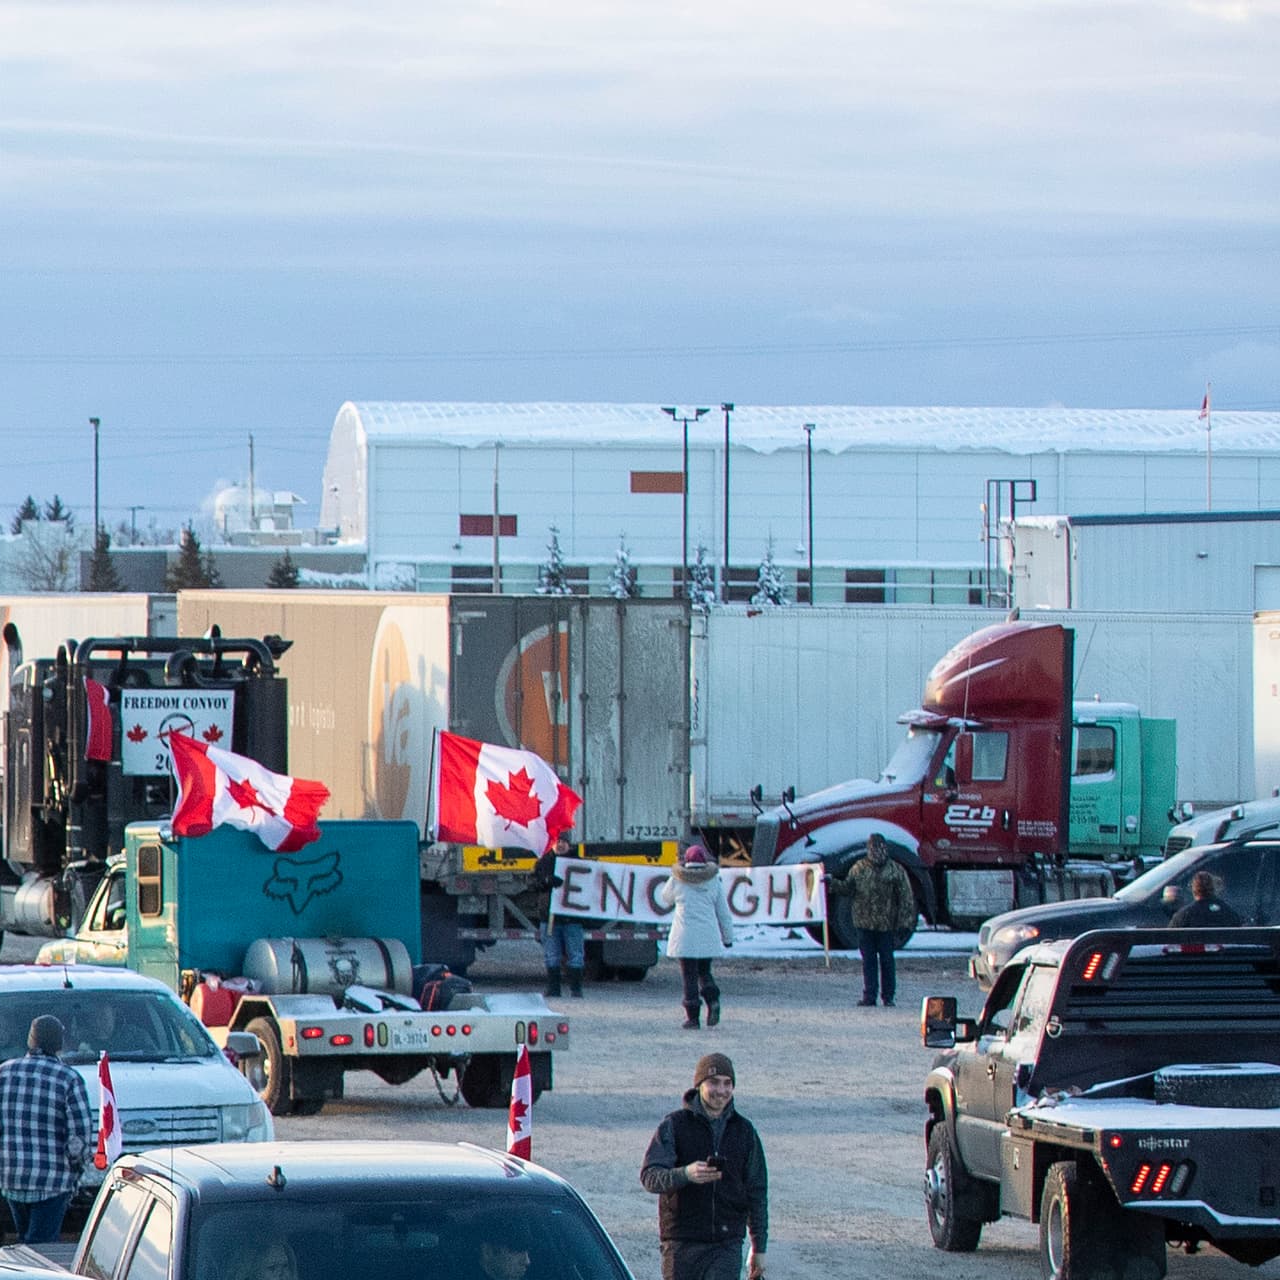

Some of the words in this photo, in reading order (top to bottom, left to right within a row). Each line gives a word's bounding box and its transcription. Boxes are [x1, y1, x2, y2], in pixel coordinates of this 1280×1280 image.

[124, 697, 180, 710] FREEDOM
[183, 697, 229, 710] CONVOY
[944, 804, 997, 826] Erb
[627, 825, 678, 837] 473223
[560, 865, 817, 920] ENOGH!
